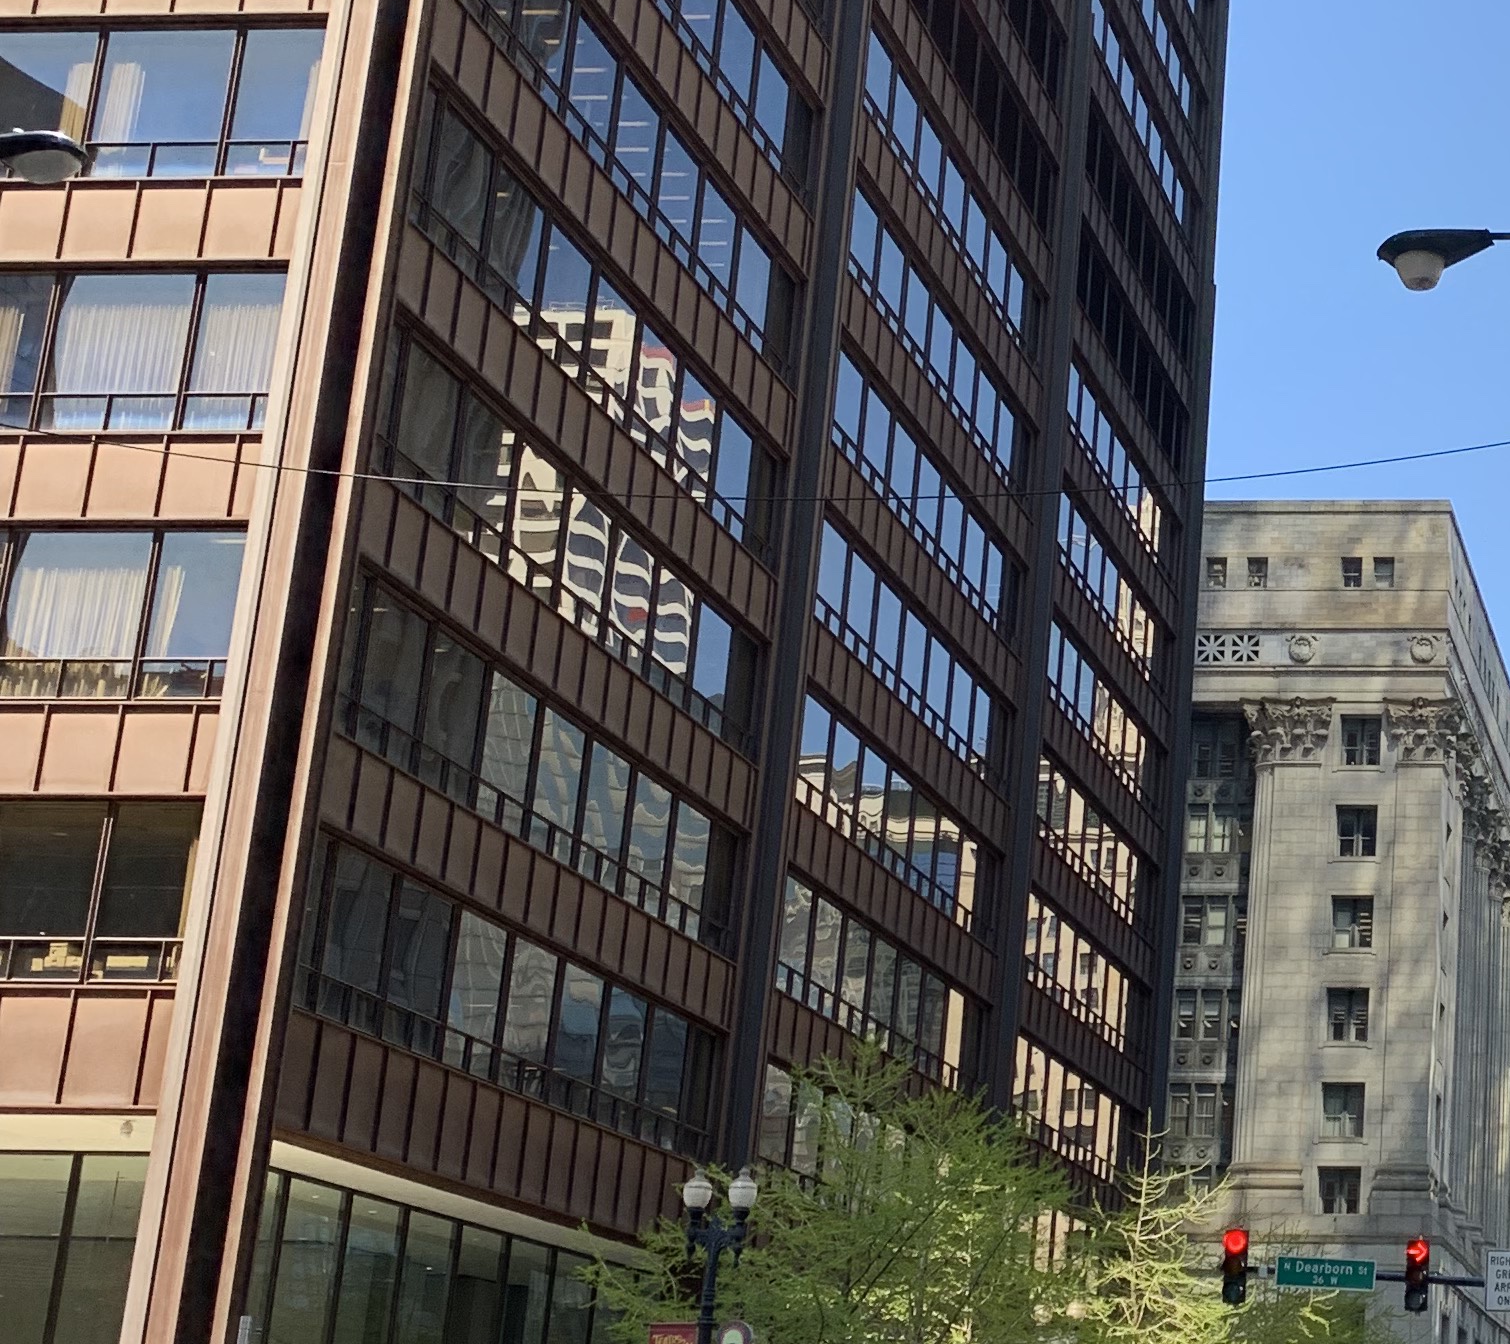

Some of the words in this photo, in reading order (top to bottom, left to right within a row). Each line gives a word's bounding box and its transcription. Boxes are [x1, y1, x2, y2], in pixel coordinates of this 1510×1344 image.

[1295, 1260, 1353, 1276] Dearborn
[1358, 1265, 1368, 1276] St
[1312, 1275, 1324, 1285] 36
[1330, 1276, 1339, 1285] W
